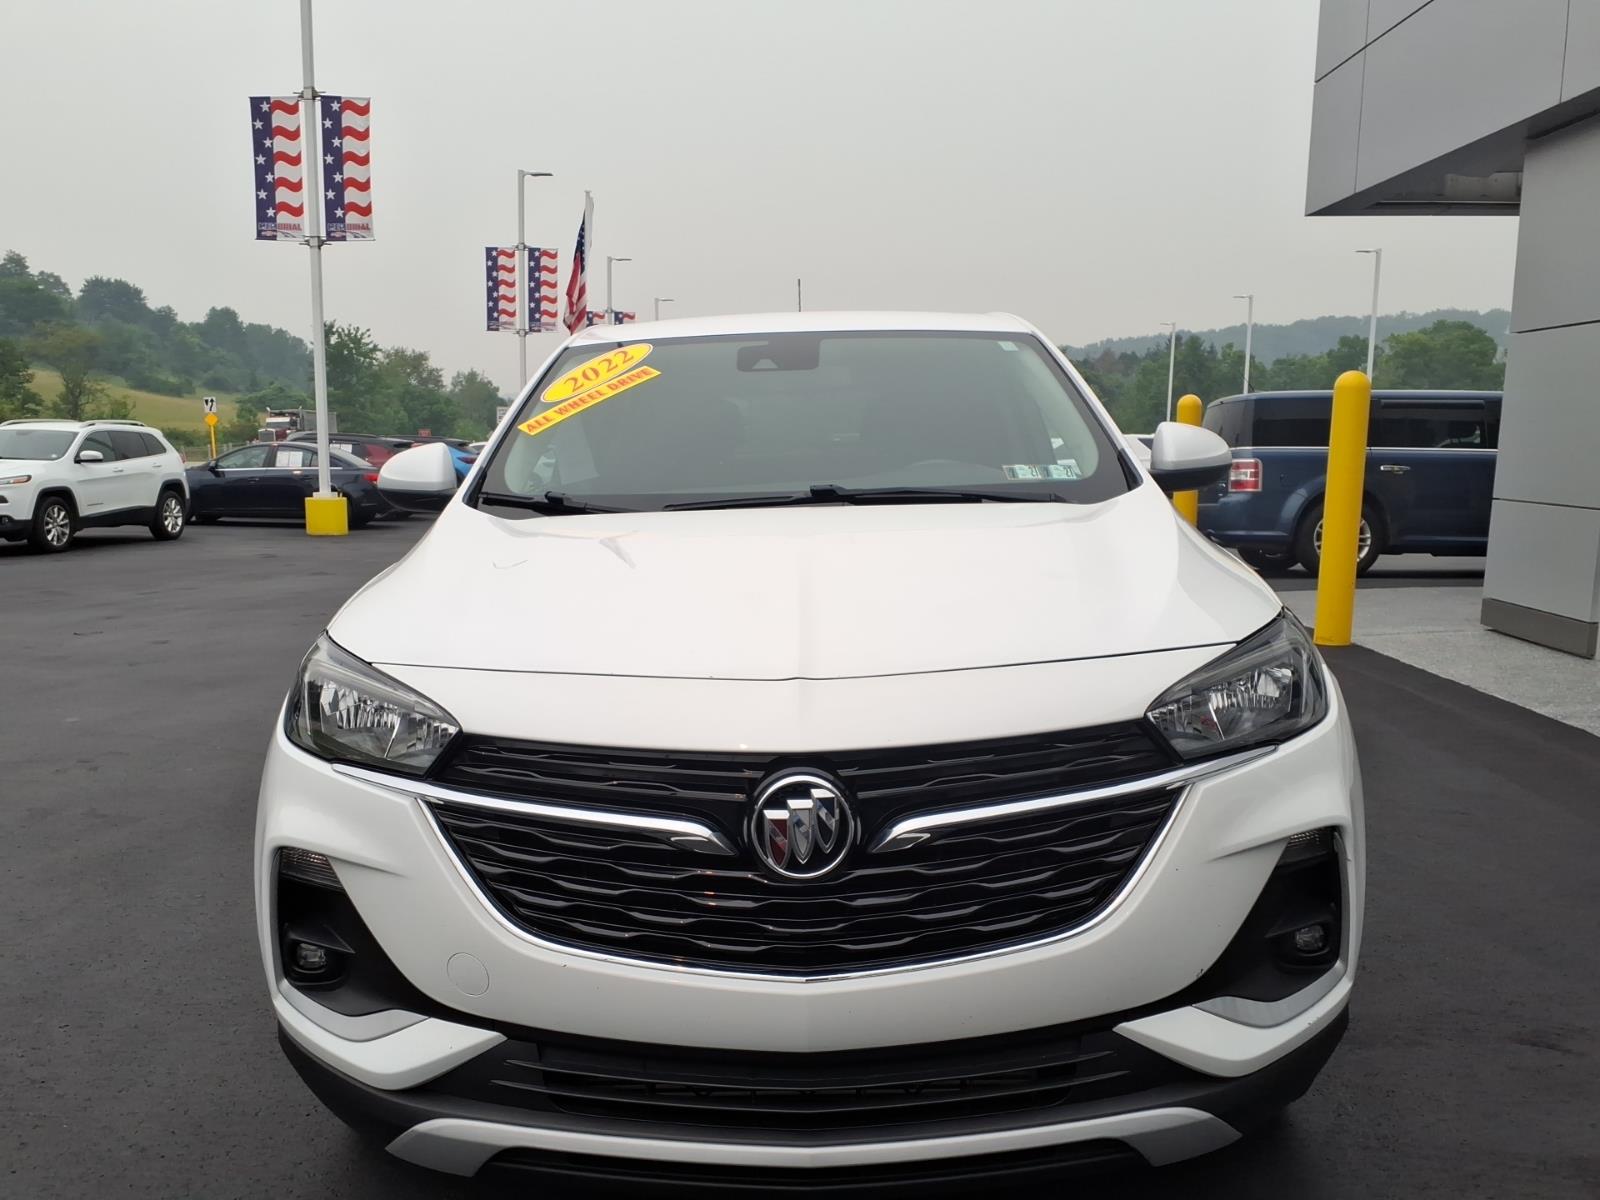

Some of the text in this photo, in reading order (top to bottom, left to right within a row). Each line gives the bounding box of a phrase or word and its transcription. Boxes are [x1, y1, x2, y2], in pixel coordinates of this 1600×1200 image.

[563, 350, 634, 392] 2022
[526, 415, 553, 433] ALL
[554, 389, 606, 416] WHEEL
[607, 368, 653, 390] DRIVE
